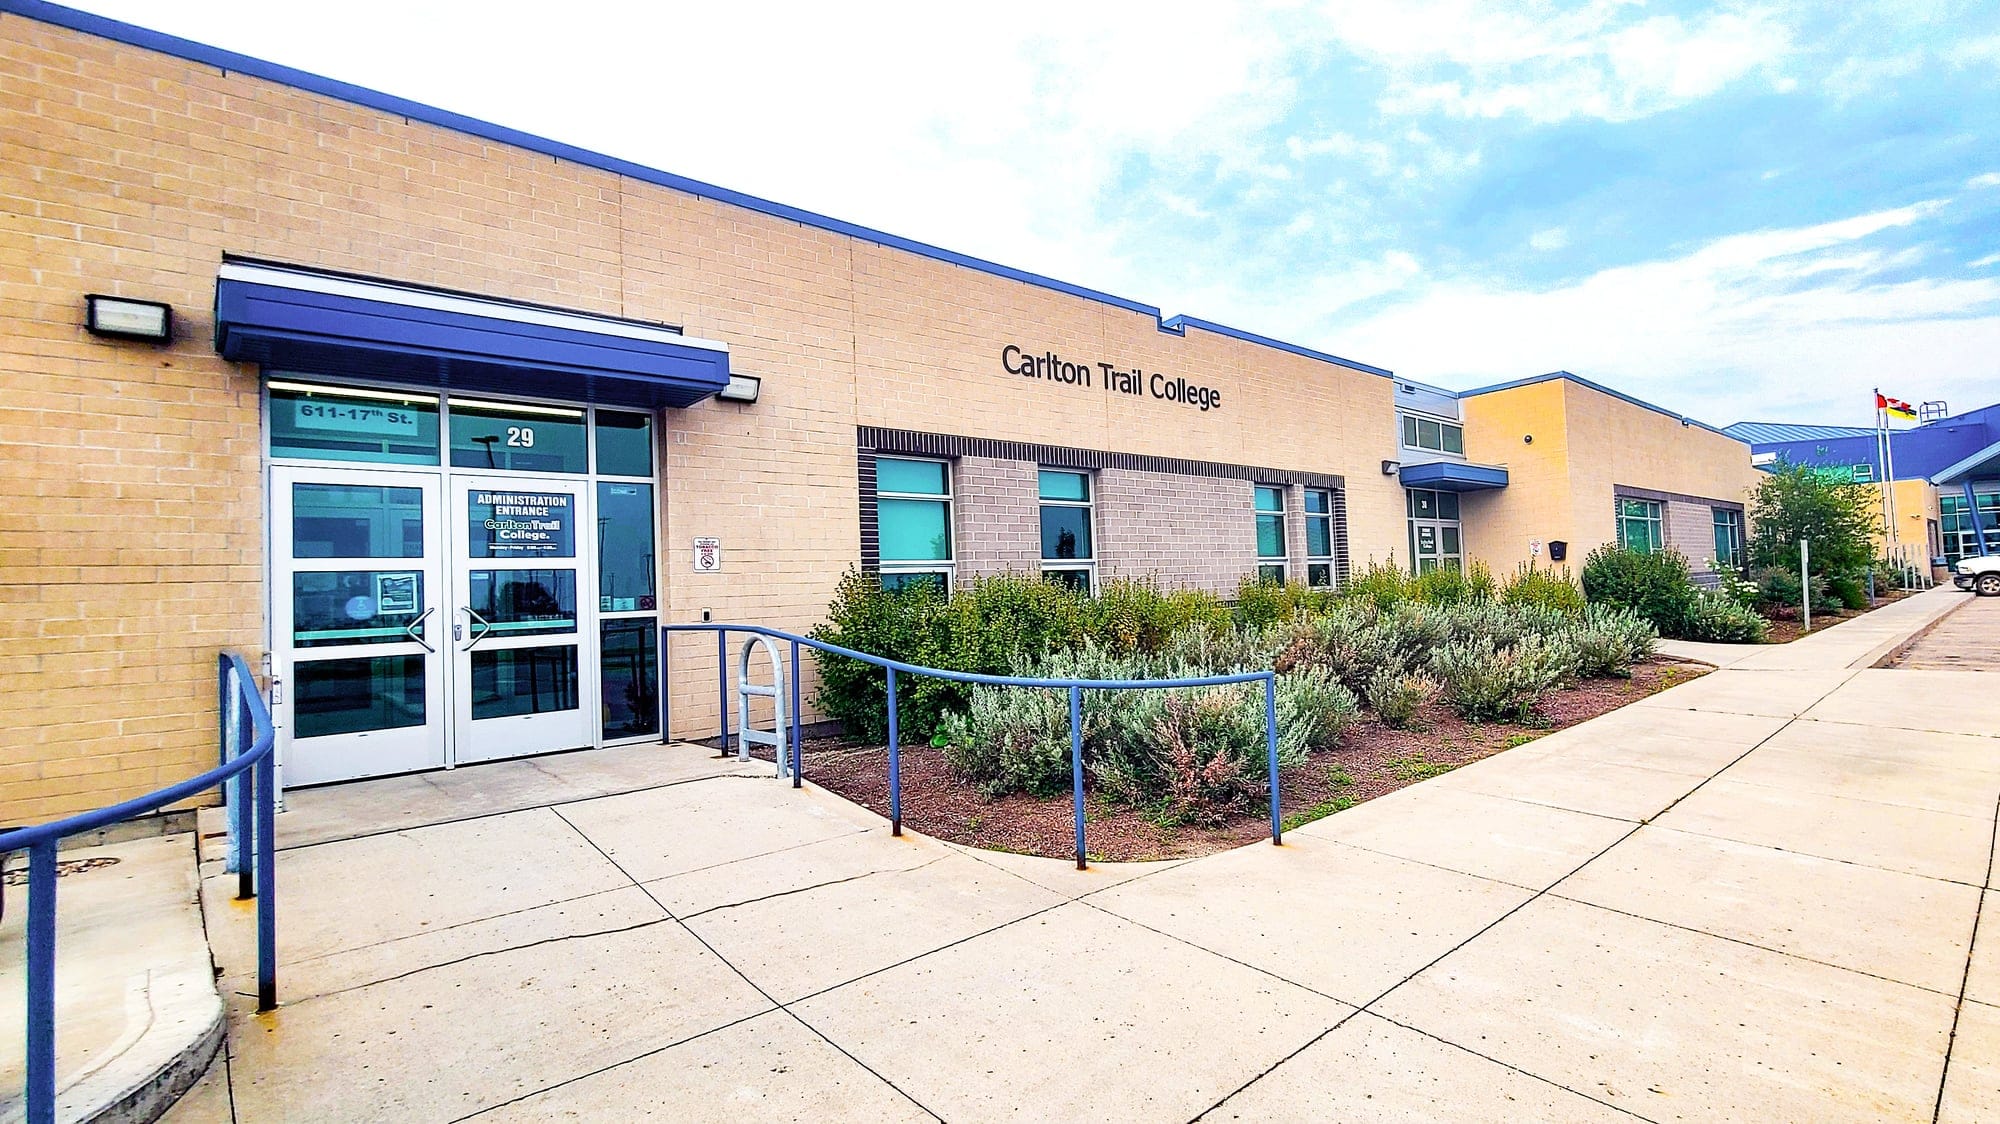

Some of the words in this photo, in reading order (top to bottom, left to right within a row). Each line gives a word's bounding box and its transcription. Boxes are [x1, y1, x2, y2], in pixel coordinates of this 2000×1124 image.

[1002, 344, 1091, 387] Carlton
[1098, 362, 1142, 396] Trail
[1150, 373, 1221, 411] College
[301, 404, 383, 421] 611-17th
[388, 412, 413, 425] St.
[507, 426, 534, 447] 29
[477, 494, 567, 507] ADMINISTRATION
[496, 505, 549, 516] ENTRANCE
